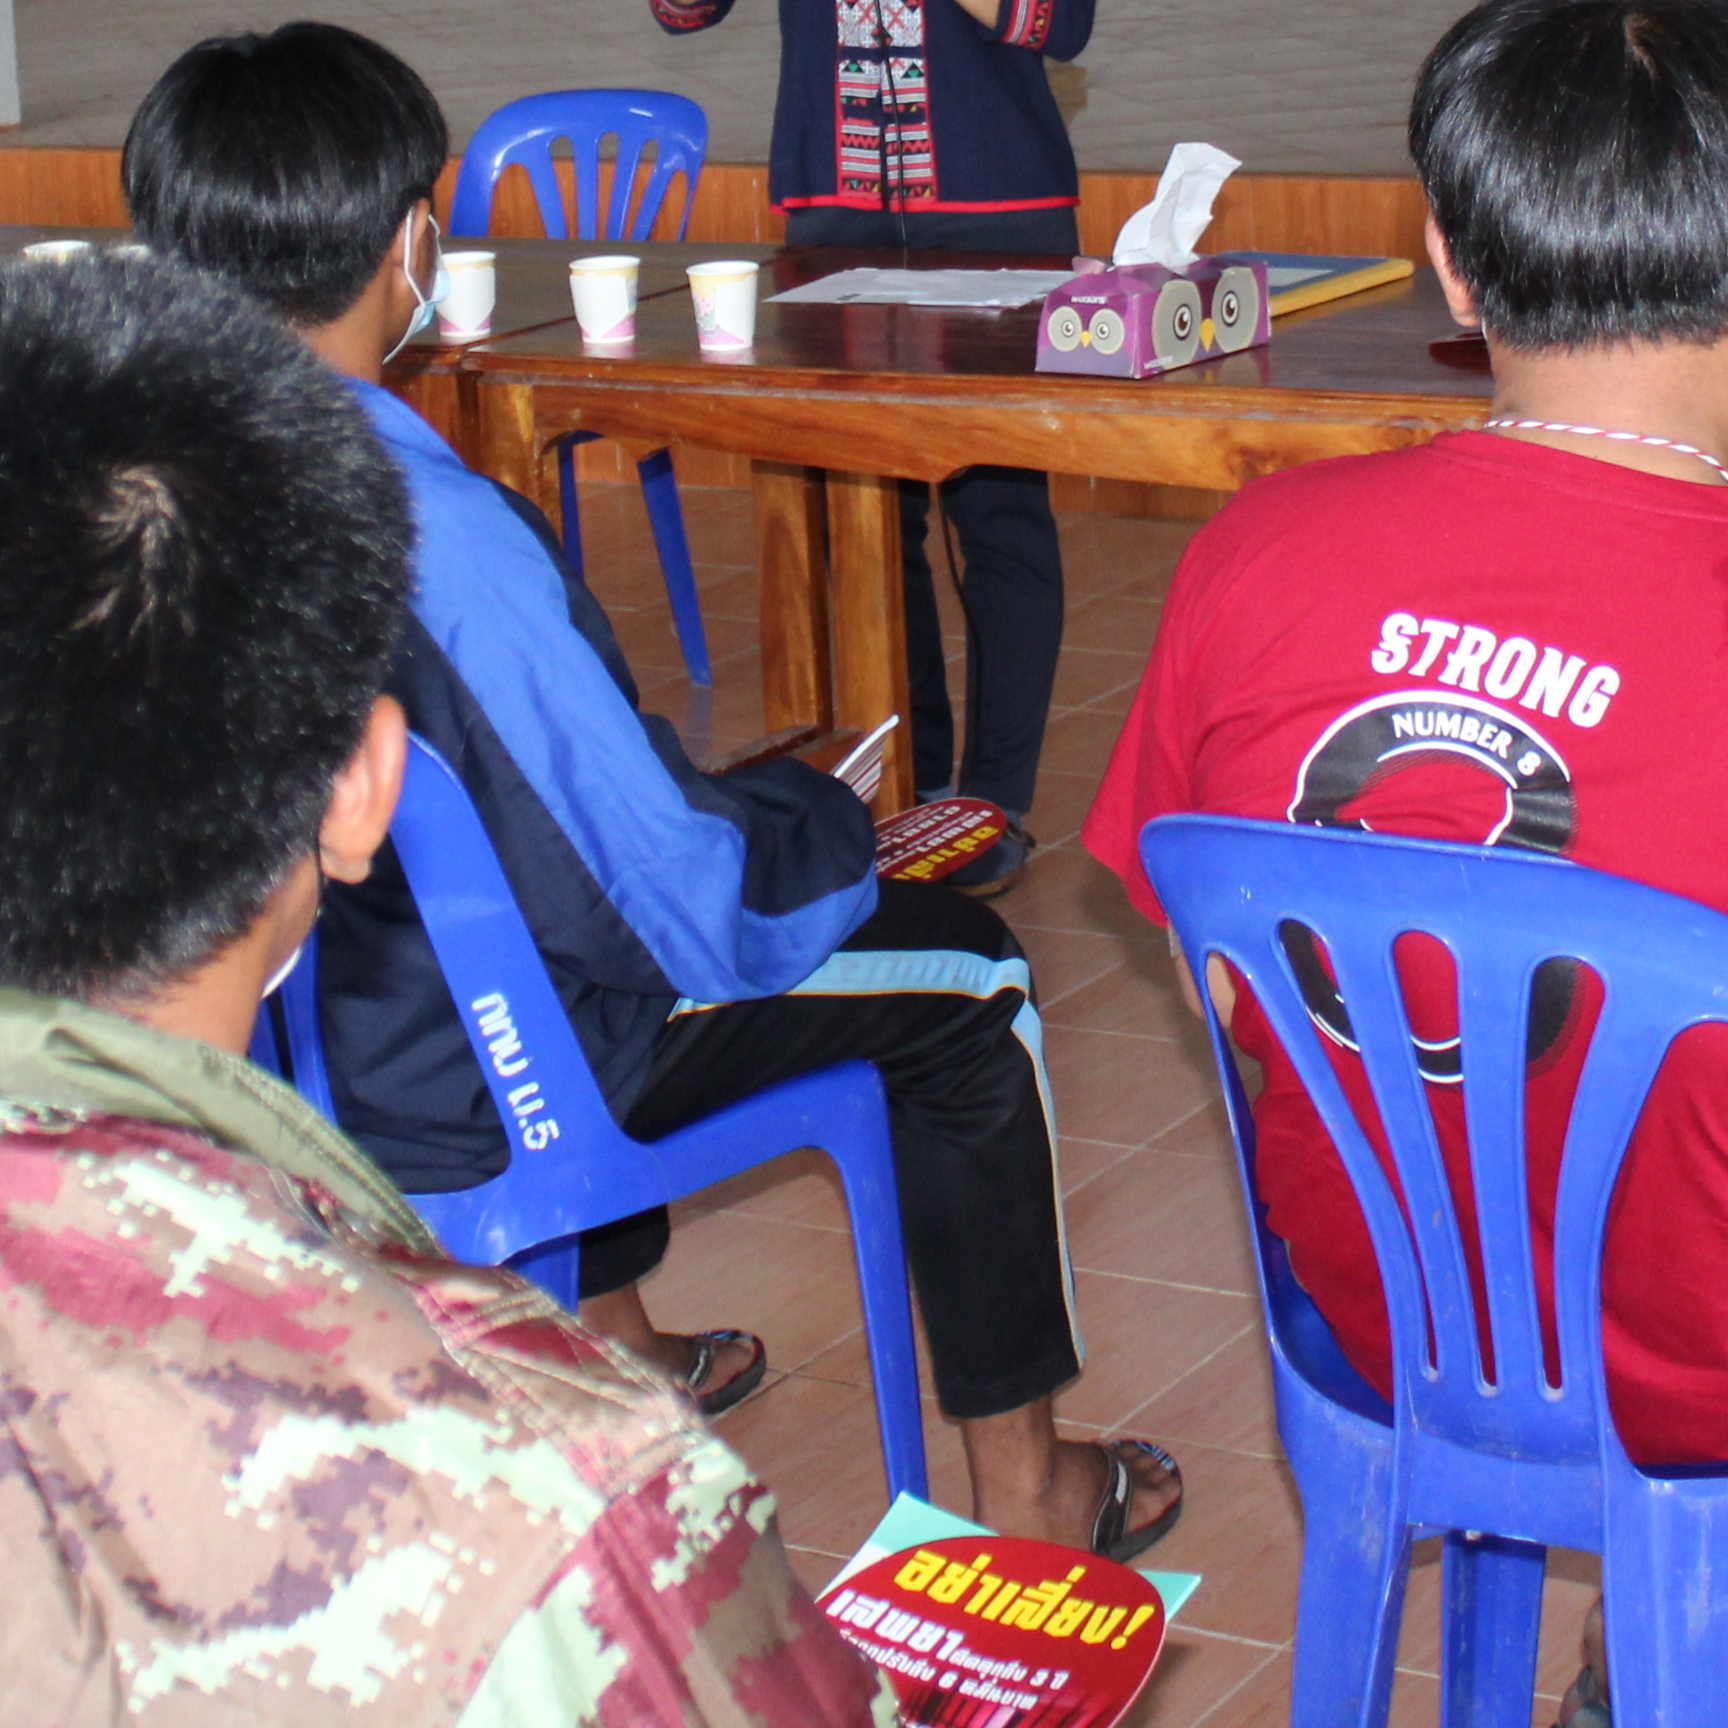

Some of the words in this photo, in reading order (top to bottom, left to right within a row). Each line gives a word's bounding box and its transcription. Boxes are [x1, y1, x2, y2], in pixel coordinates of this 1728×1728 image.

[1371, 613, 1620, 728] STRONG
[1391, 711, 1513, 759] NUMBER
[1517, 750, 1541, 776] 8
[893, 1548, 1156, 1650] อย่าเสี่ยง!
[938, 1670, 960, 1689] 6
[1029, 1670, 1053, 1688] 3
